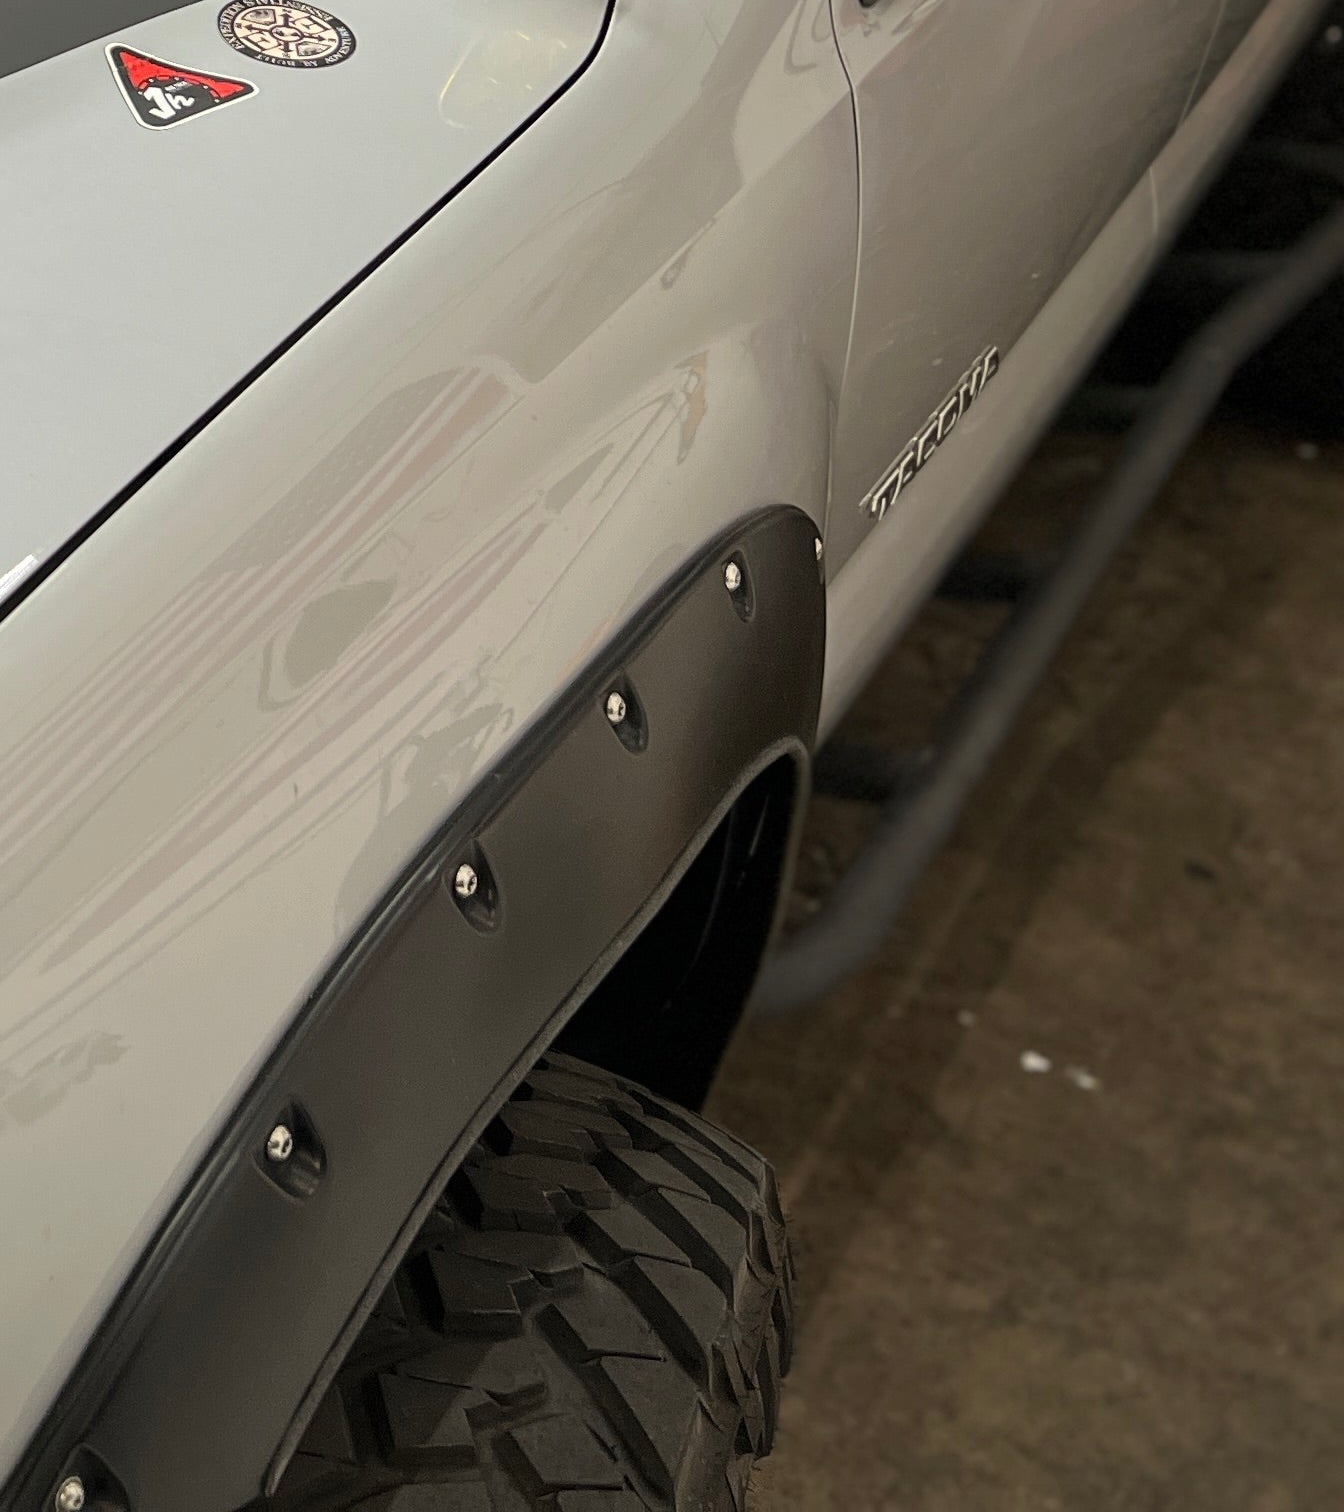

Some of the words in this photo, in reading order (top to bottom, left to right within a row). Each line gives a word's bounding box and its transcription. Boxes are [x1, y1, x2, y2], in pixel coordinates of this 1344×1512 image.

[219, 2, 246, 50] EXPEDITION
[254, 53, 296, 66] BUILT
[859, 345, 999, 521] TACOMA
